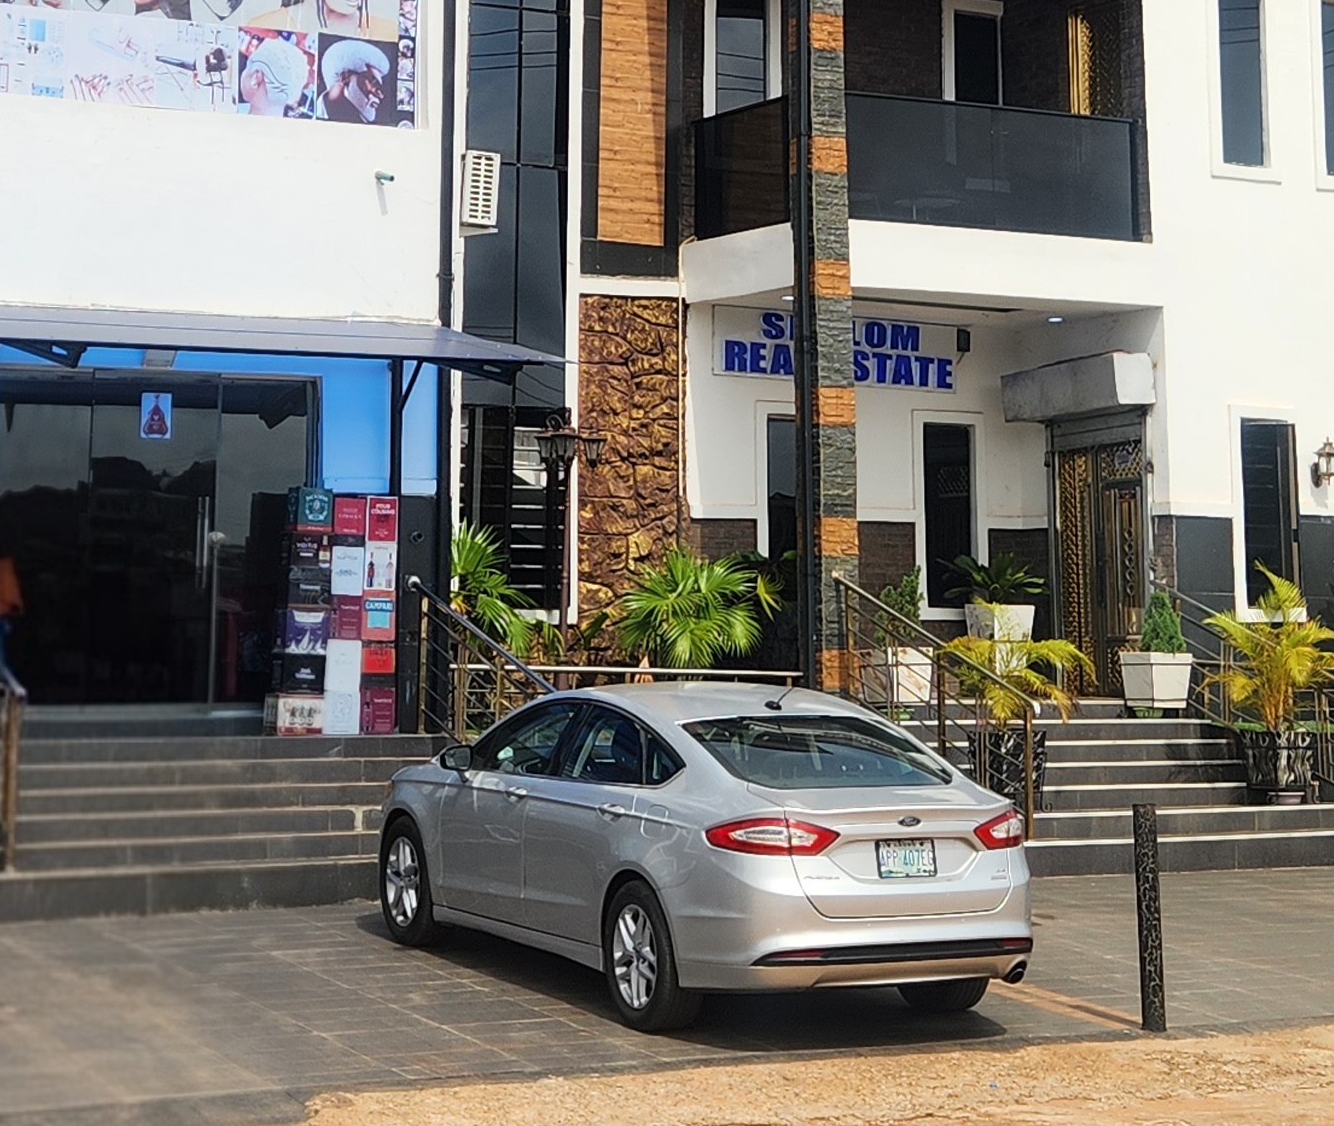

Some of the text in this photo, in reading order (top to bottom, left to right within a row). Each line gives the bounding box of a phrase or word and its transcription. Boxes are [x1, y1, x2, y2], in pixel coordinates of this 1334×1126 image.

[762, 311, 920, 352] SLOM
[724, 339, 953, 390] REA STATE
